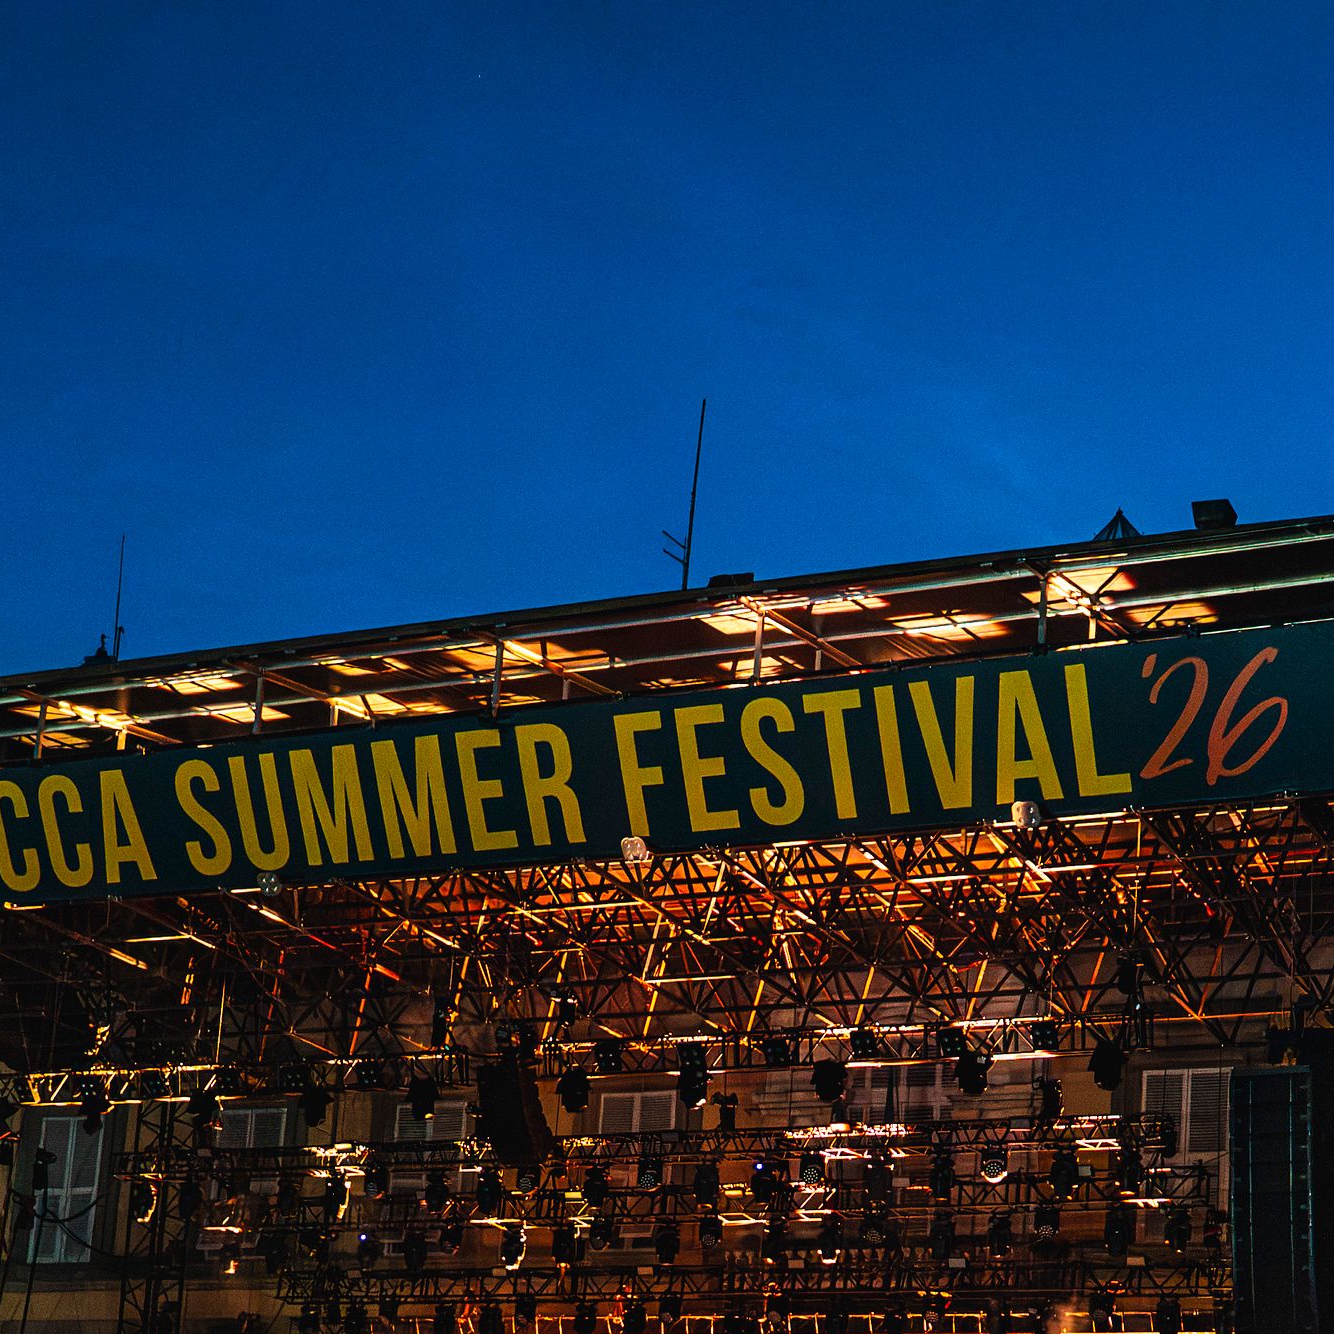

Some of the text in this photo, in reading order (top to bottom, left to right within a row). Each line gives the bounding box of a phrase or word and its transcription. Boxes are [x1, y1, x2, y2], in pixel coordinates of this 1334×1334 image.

[175, 720, 584, 881] SUMMER
[612, 660, 1134, 840] FESTIVAL
[1139, 645, 1290, 787] '26
